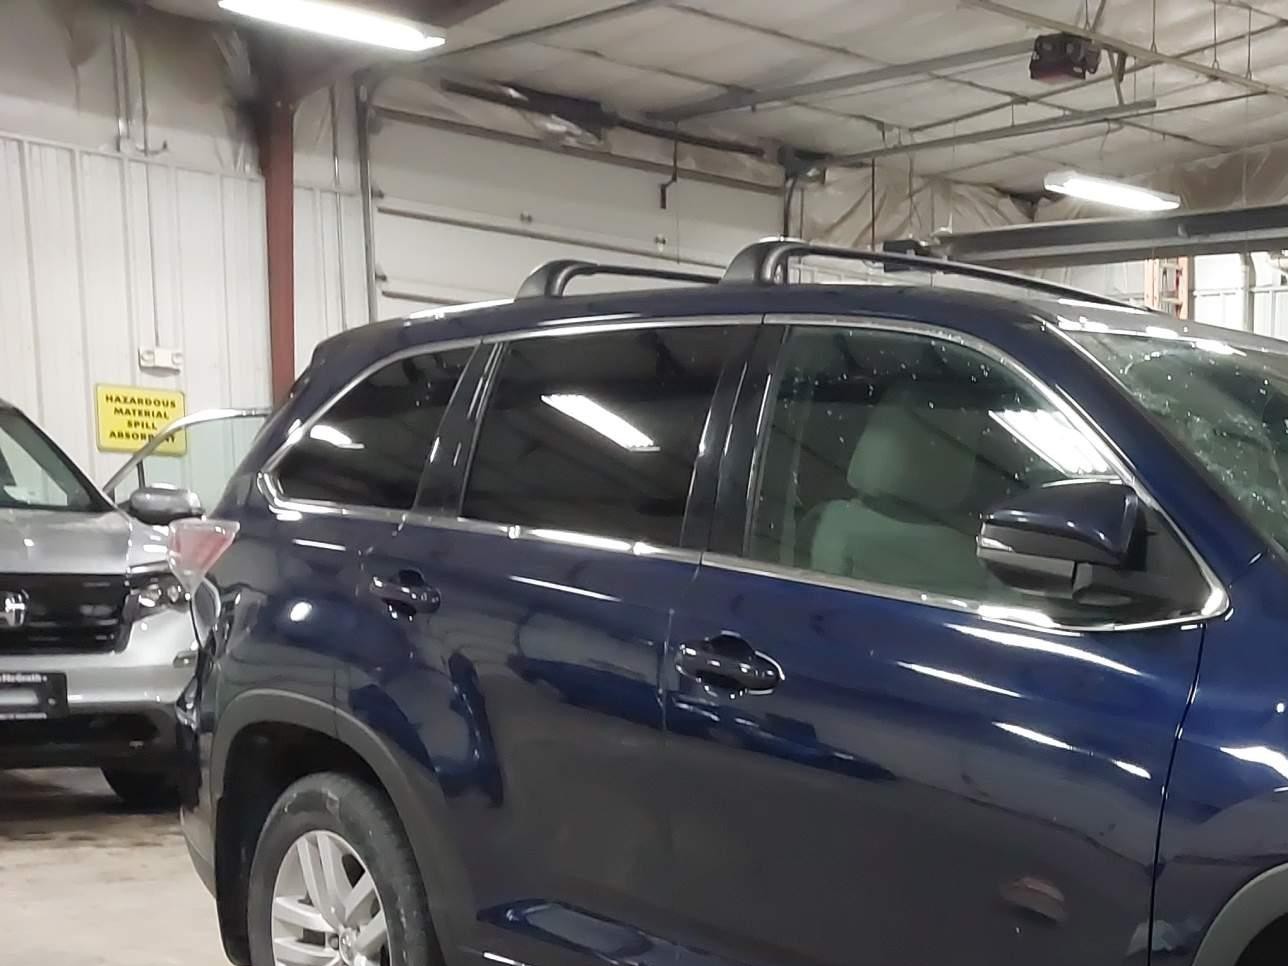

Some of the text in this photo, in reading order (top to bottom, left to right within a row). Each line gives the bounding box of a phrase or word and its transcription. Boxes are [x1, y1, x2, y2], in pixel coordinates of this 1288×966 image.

[105, 394, 176, 408] HAZARDOUS
[113, 406, 169, 419] MATERIAL
[127, 420, 158, 431] SPILL
[108, 431, 176, 444] ABSORBT
